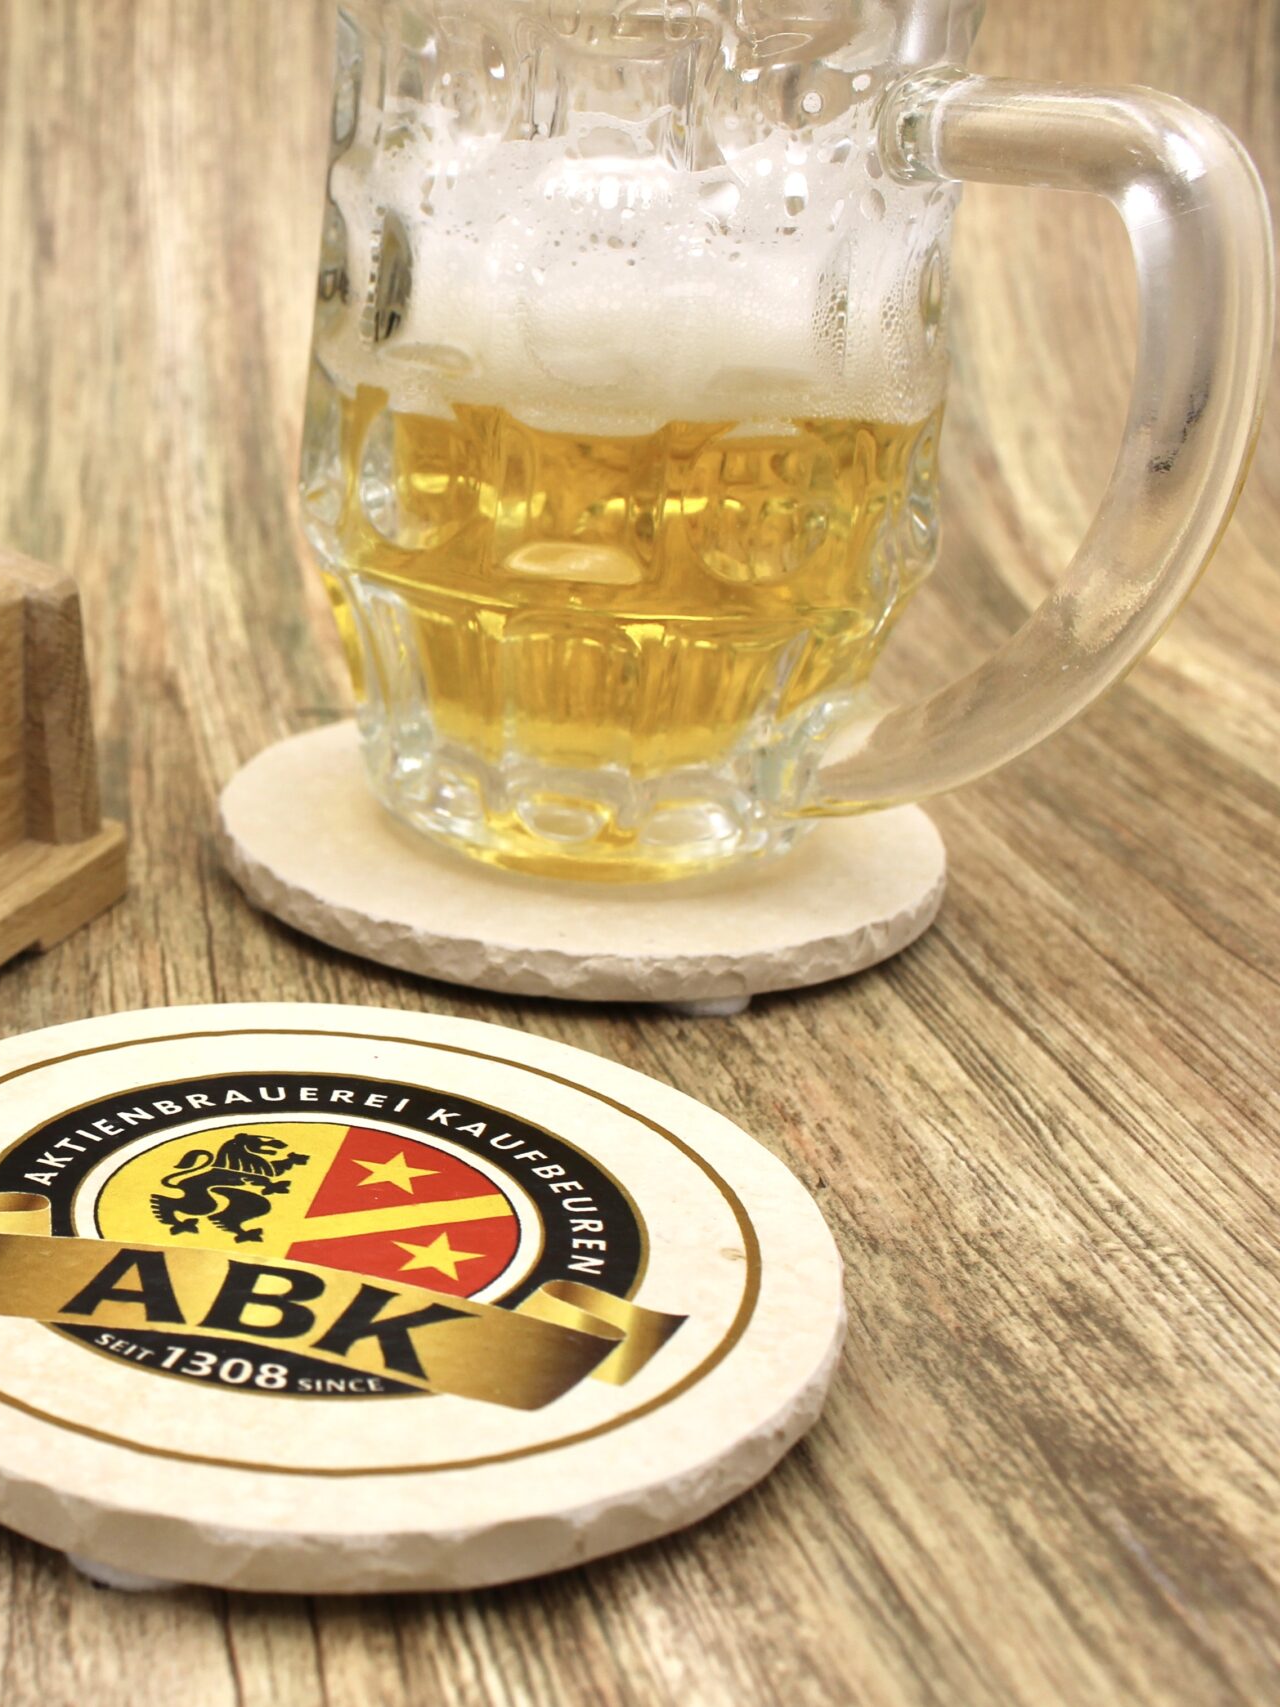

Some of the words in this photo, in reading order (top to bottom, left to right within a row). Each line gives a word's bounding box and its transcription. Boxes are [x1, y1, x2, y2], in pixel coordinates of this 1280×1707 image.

[23, 1086, 411, 1187] AKTIENBRAUEREI
[428, 1107, 607, 1276] KAUFBEUREN
[59, 1248, 482, 1382] ABK
[94, 1333, 155, 1361] SEIT
[160, 1345, 288, 1389] 1308
[298, 1377, 385, 1393] SINCE
